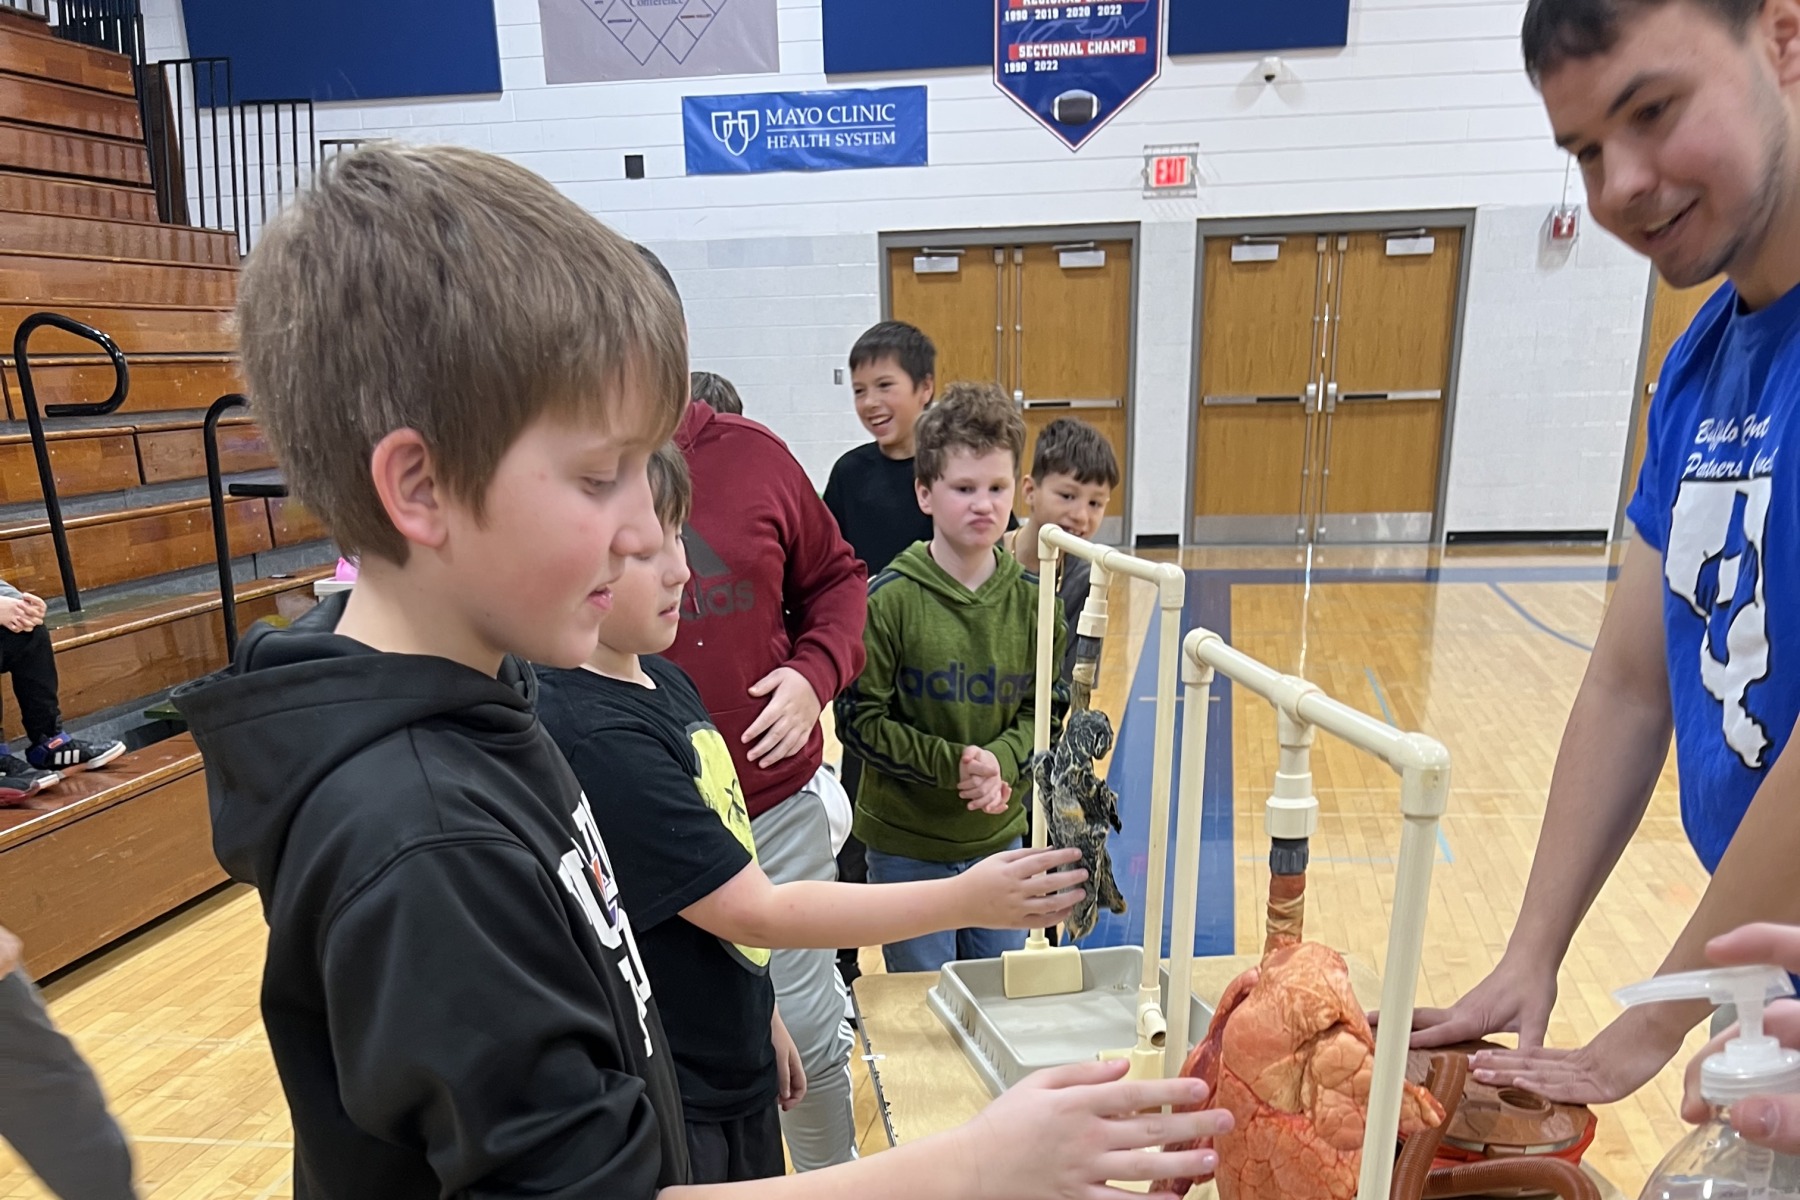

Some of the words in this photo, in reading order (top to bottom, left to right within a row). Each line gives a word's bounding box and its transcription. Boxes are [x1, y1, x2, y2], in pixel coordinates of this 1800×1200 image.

[1066, 6, 1091, 18] 2020
[1097, 4, 1122, 17] 2022
[1018, 43, 1084, 59] SECTIONAL
[1087, 39, 1136, 55] CHAMPS
[1034, 60, 1058, 72] 2022
[766, 107, 823, 126] MAYO
[827, 103, 896, 123] CLINIC
[767, 134, 830, 150] HEALTH
[834, 131, 896, 147] SYSTEM
[1156, 157, 1186, 184] EXIT
